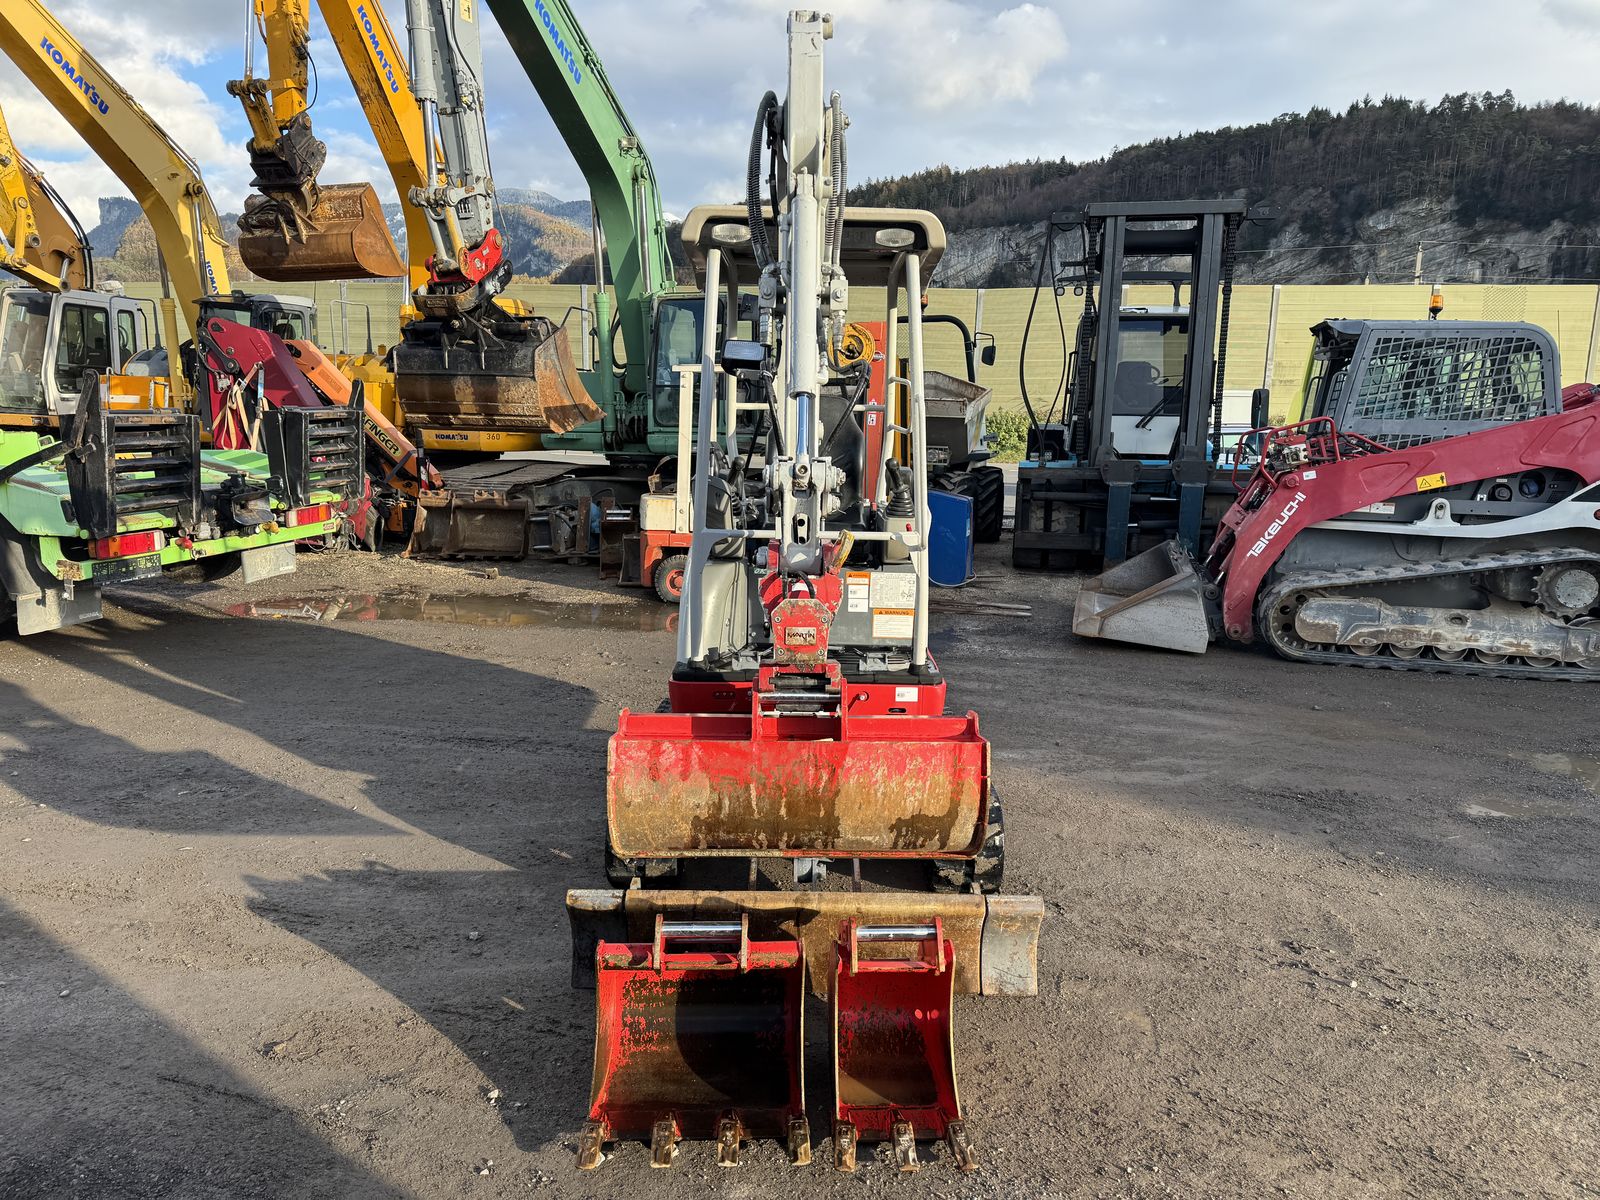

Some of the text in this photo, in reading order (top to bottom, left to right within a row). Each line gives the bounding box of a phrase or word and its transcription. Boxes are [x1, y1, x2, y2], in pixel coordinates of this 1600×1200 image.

[40, 35, 110, 115] KOMATSU
[357, 4, 400, 94] KOMATSU
[535, 0, 581, 85] KOMATSU
[435, 432, 500, 441] KOMATSU 360
[1246, 491, 1307, 557] TAKEUCHI
